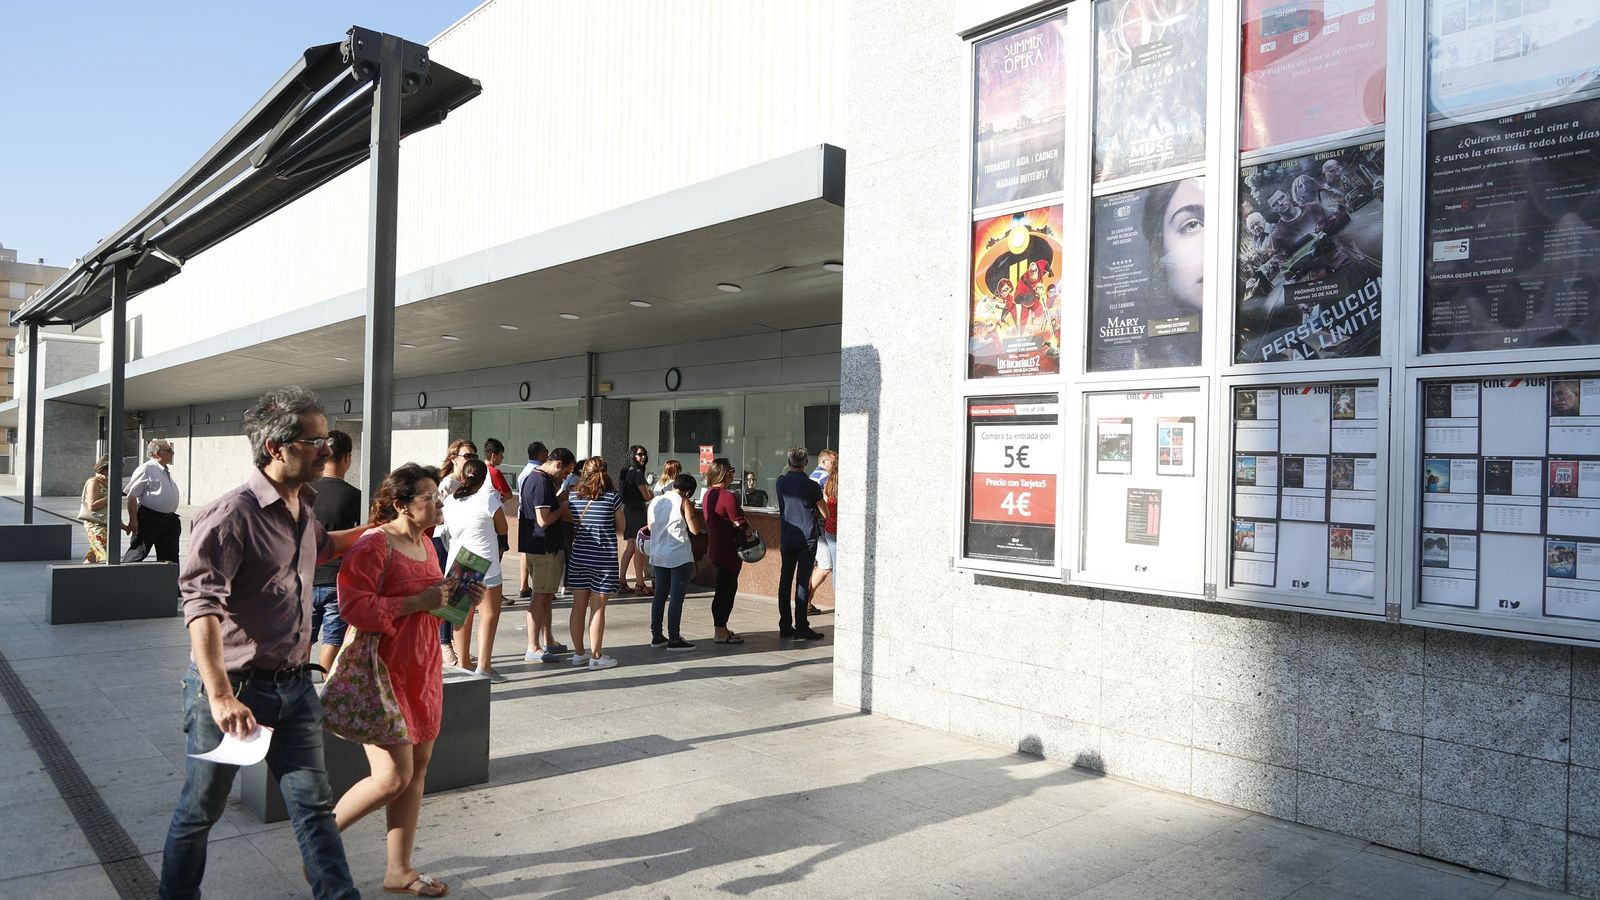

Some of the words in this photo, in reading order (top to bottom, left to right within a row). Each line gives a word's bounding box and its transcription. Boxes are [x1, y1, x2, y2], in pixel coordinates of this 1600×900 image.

[1004, 34, 1043, 59] SUMMER
[1004, 49, 1044, 73] OPERA
[1498, 117, 1513, 125] CINE
[1523, 112, 1537, 120] SUR
[1458, 133, 1502, 149] ¿Quieres
[1504, 129, 1532, 140] venir
[1533, 125, 1544, 136] al
[1546, 122, 1569, 133] cine
[1572, 120, 1580, 128] a
[1130, 135, 1175, 158] MUSE
[1434, 155, 1441, 164] 5
[1442, 151, 1469, 163] euros
[1471, 149, 1481, 158] la
[1484, 141, 1526, 156] entrada
[1528, 137, 1556, 149] todos
[1559, 134, 1574, 144] los
[1576, 130, 1600, 141] días
[984, 159, 1011, 174] TURANDOT
[1016, 156, 1030, 167] AIDA
[1035, 148, 1058, 162] CARMEN
[1314, 149, 1345, 161] KINGSLEY
[996, 176, 1020, 189] MADAMA
[1020, 167, 1050, 184] BUTTERFLY
[1455, 271, 1472, 280] DESDE
[1480, 269, 1500, 277] PRIMER
[1501, 266, 1514, 274] DÍA!
[1294, 286, 1316, 296] PRÓXIMO
[1316, 283, 1338, 292] ESTRENO
[1107, 316, 1139, 329] MARY
[1099, 325, 1146, 338] SHELLEY
[1292, 342, 1315, 361] AL
[1318, 301, 1381, 349] LÍMITE
[997, 357, 1006, 370] LOS
[1035, 354, 1041, 367] 2
[1281, 386, 1300, 396] CINE
[1313, 385, 1330, 395] SUR
[1483, 378, 1506, 389] CINE
[1525, 377, 1546, 388] SUR
[981, 432, 1005, 441] Compra
[1006, 432, 1013, 440] tu
[1014, 431, 1039, 440] entrada
[1040, 433, 1052, 441] por
[1004, 445, 1030, 468] 5€
[985, 477, 1007, 487] Precio
[1020, 478, 1047, 489] Tarjeta5
[1000, 491, 1032, 517] 4€
